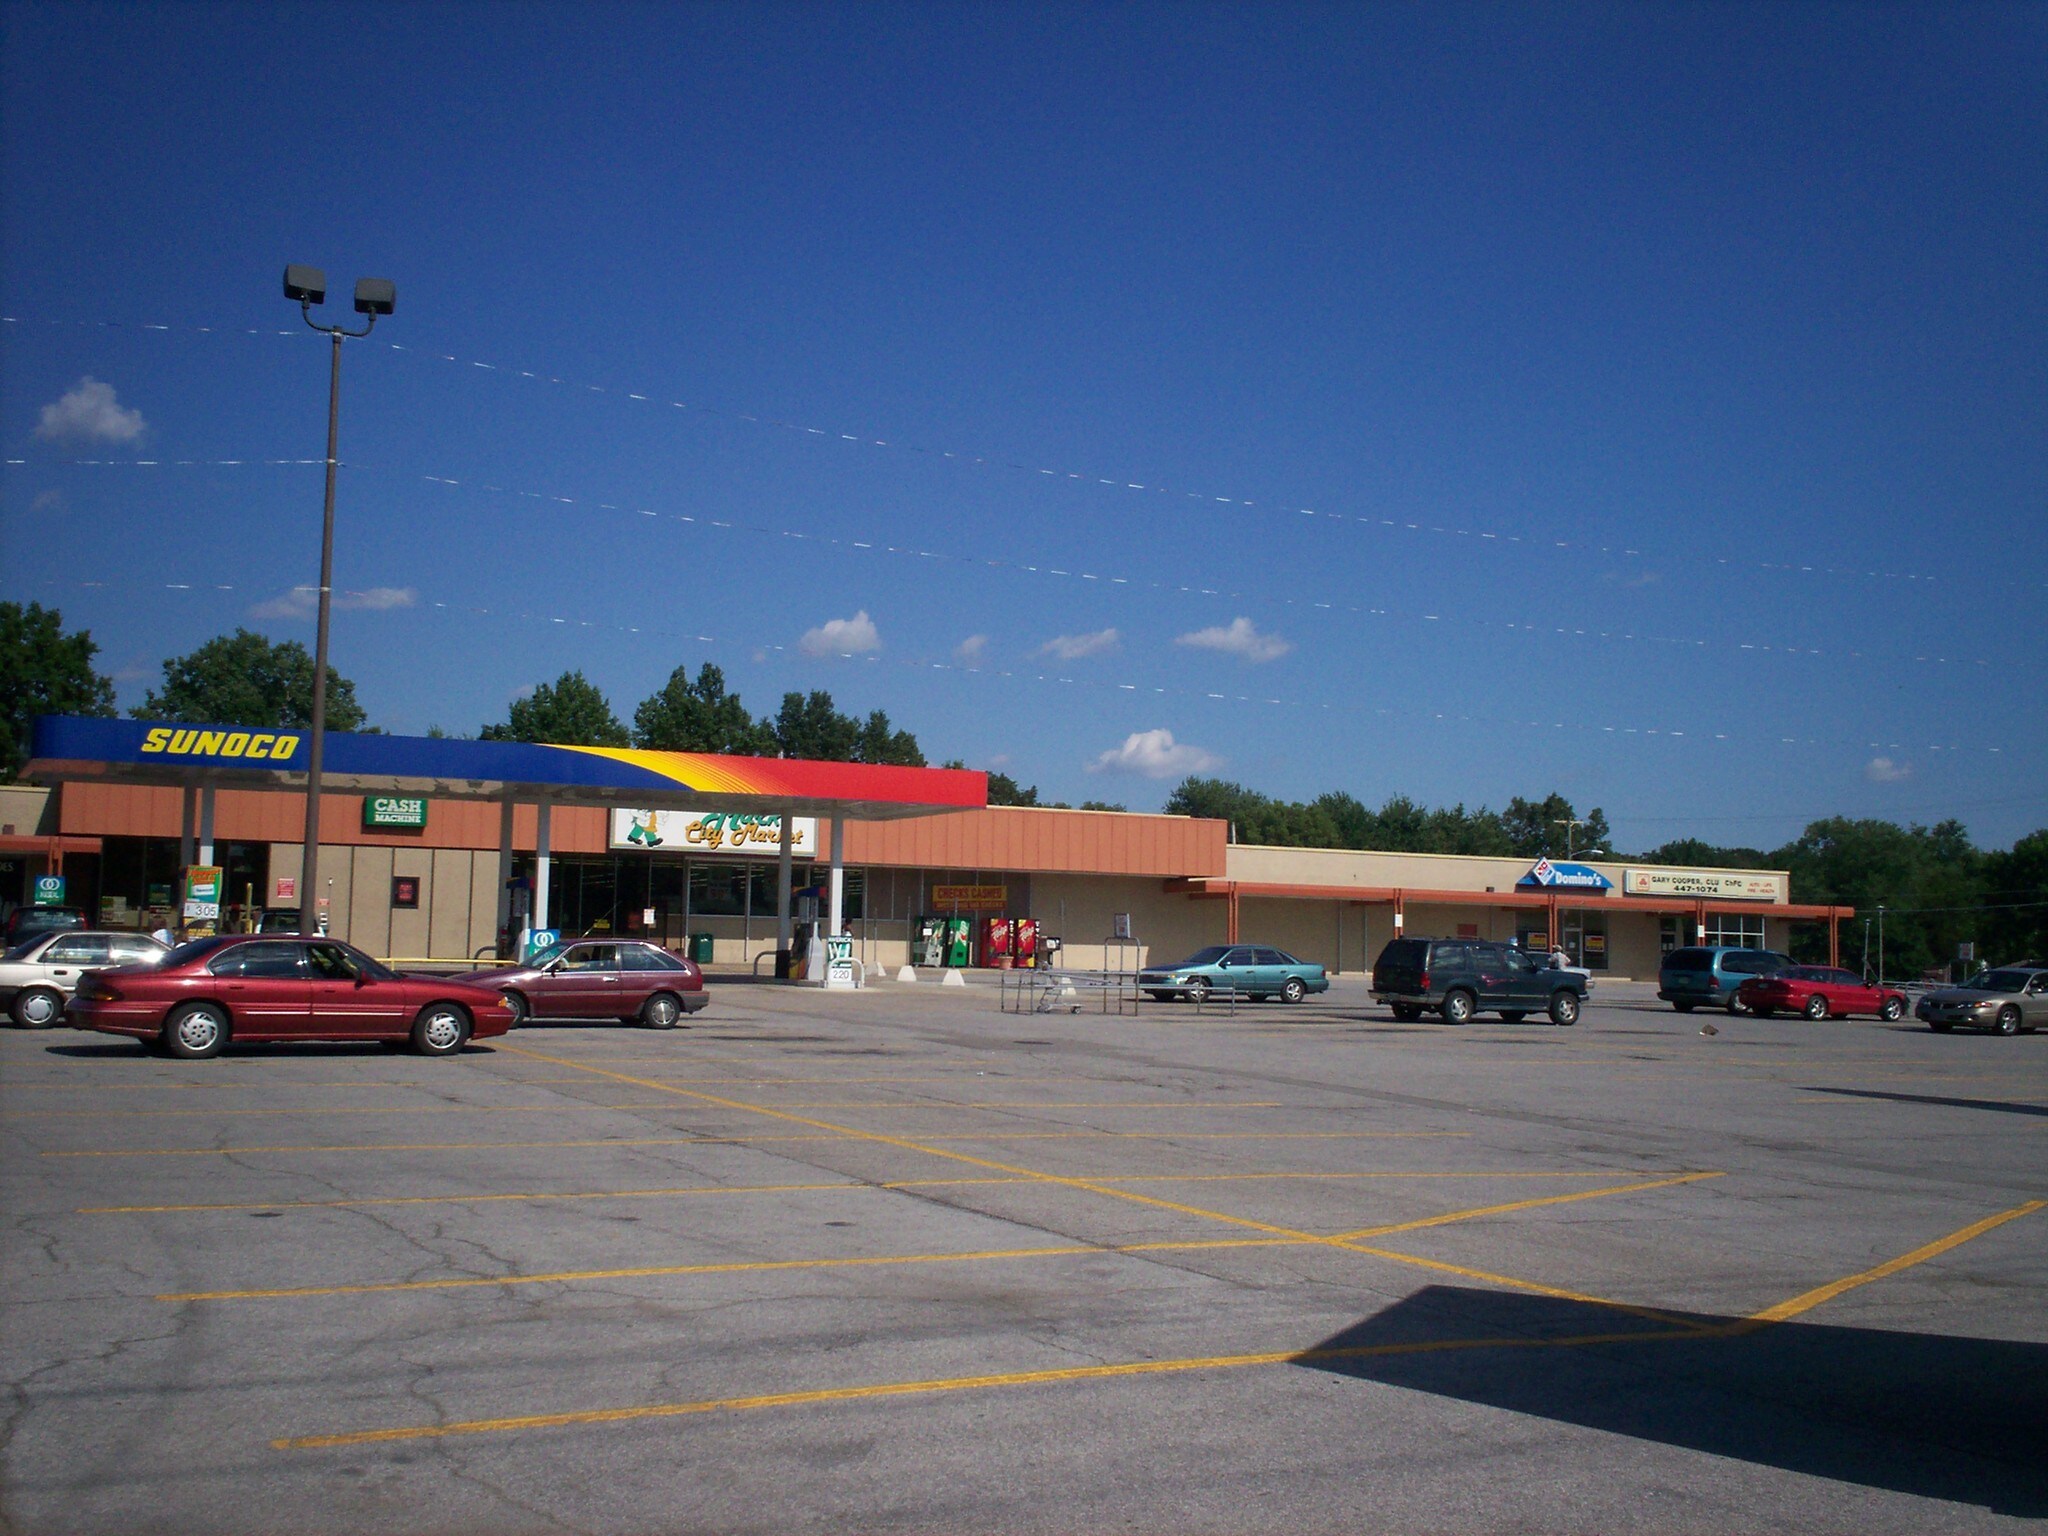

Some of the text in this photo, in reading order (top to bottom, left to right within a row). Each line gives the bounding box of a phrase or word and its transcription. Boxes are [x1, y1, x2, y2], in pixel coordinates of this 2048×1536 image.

[141, 728, 299, 760] SUNOCO
[374, 798, 422, 812] CASH
[375, 814, 422, 823] MACHINE
[685, 820, 725, 850] City
[1555, 871, 1602, 886] Domino's
[1673, 885, 1719, 893] 447-1074
[195, 905, 217, 917] 305
[833, 970, 850, 979] 220
